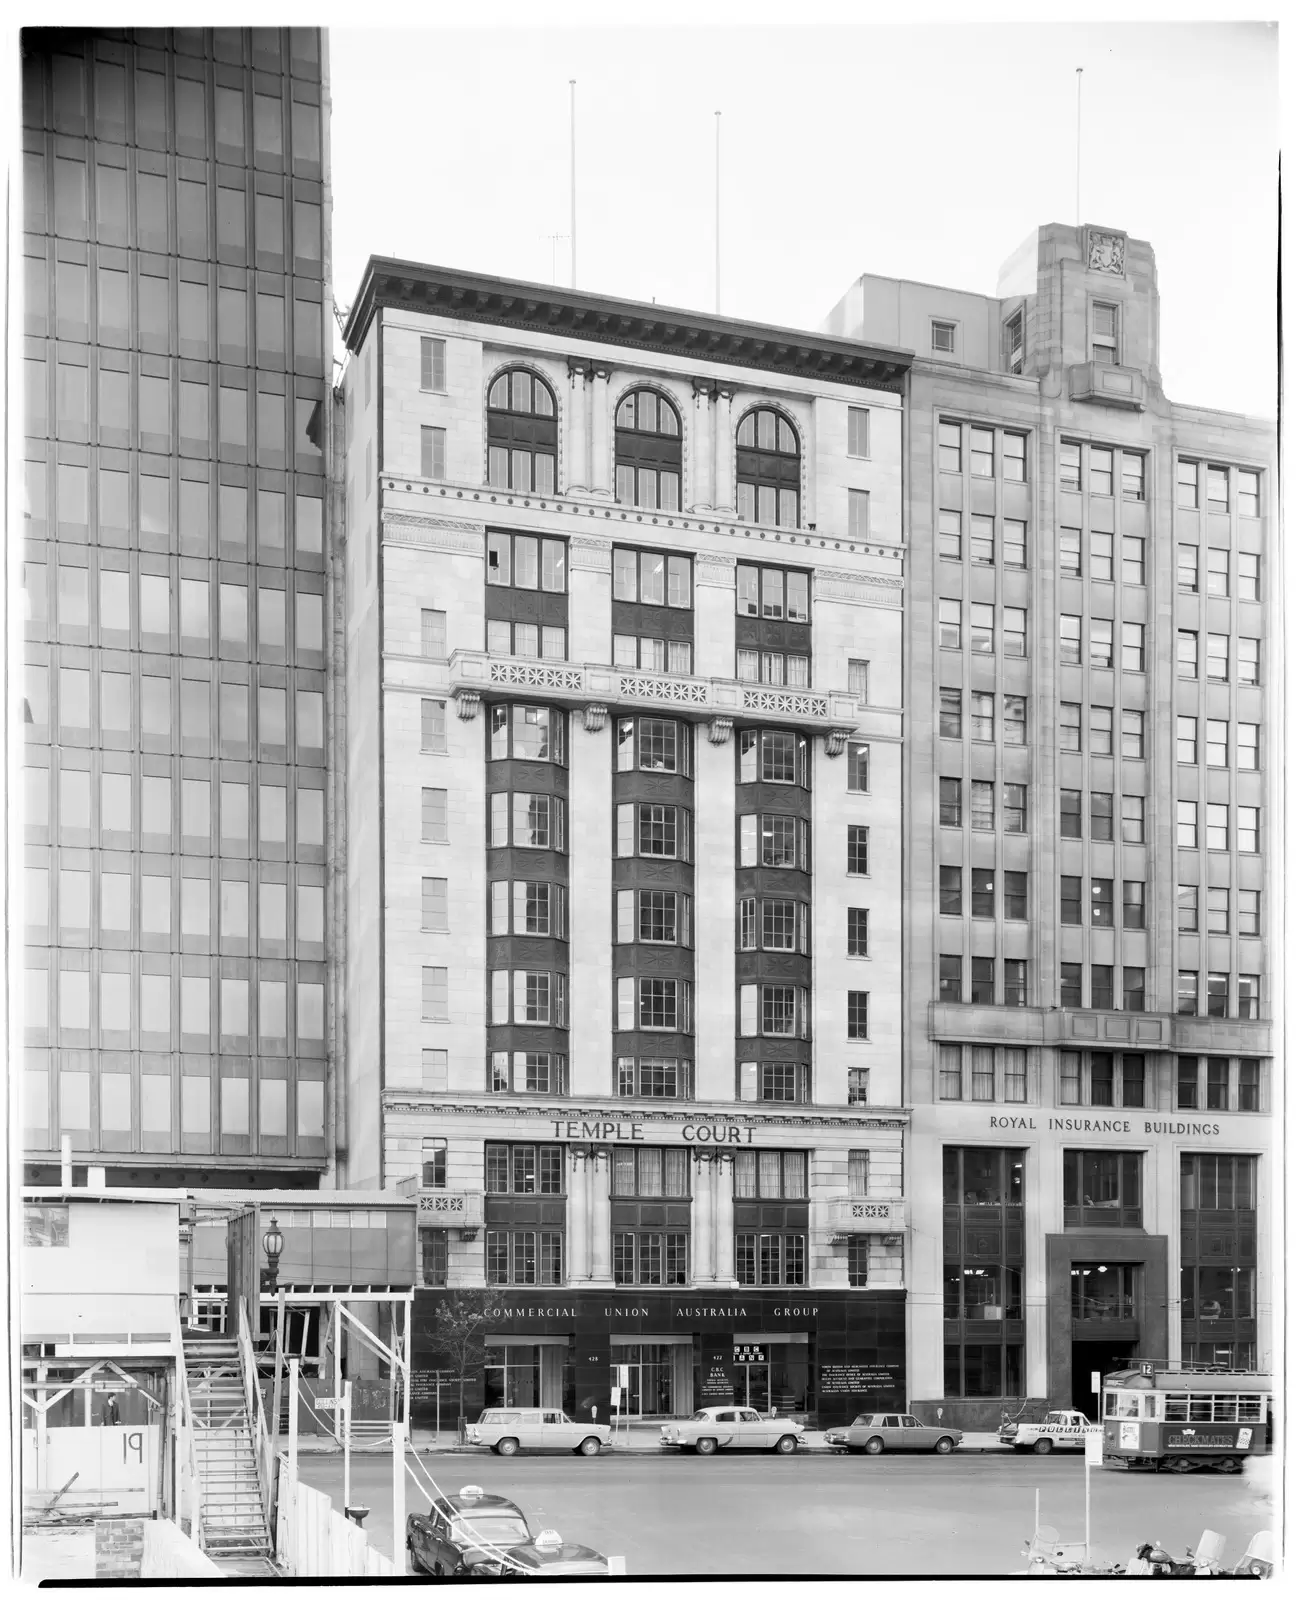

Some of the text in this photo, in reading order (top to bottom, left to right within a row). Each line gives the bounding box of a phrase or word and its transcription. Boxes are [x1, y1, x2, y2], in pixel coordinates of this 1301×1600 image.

[990, 1116, 1220, 1136] ROYAL INSURANCE BUILDINGS
[551, 1120, 757, 1143] TEMPLE COURT
[483, 1307, 819, 1317] COMMERCIAL UNION AUSTRALIA GROUP
[1142, 1365, 1152, 1374] 12
[1168, 1435, 1233, 1445] CHECKMATES
